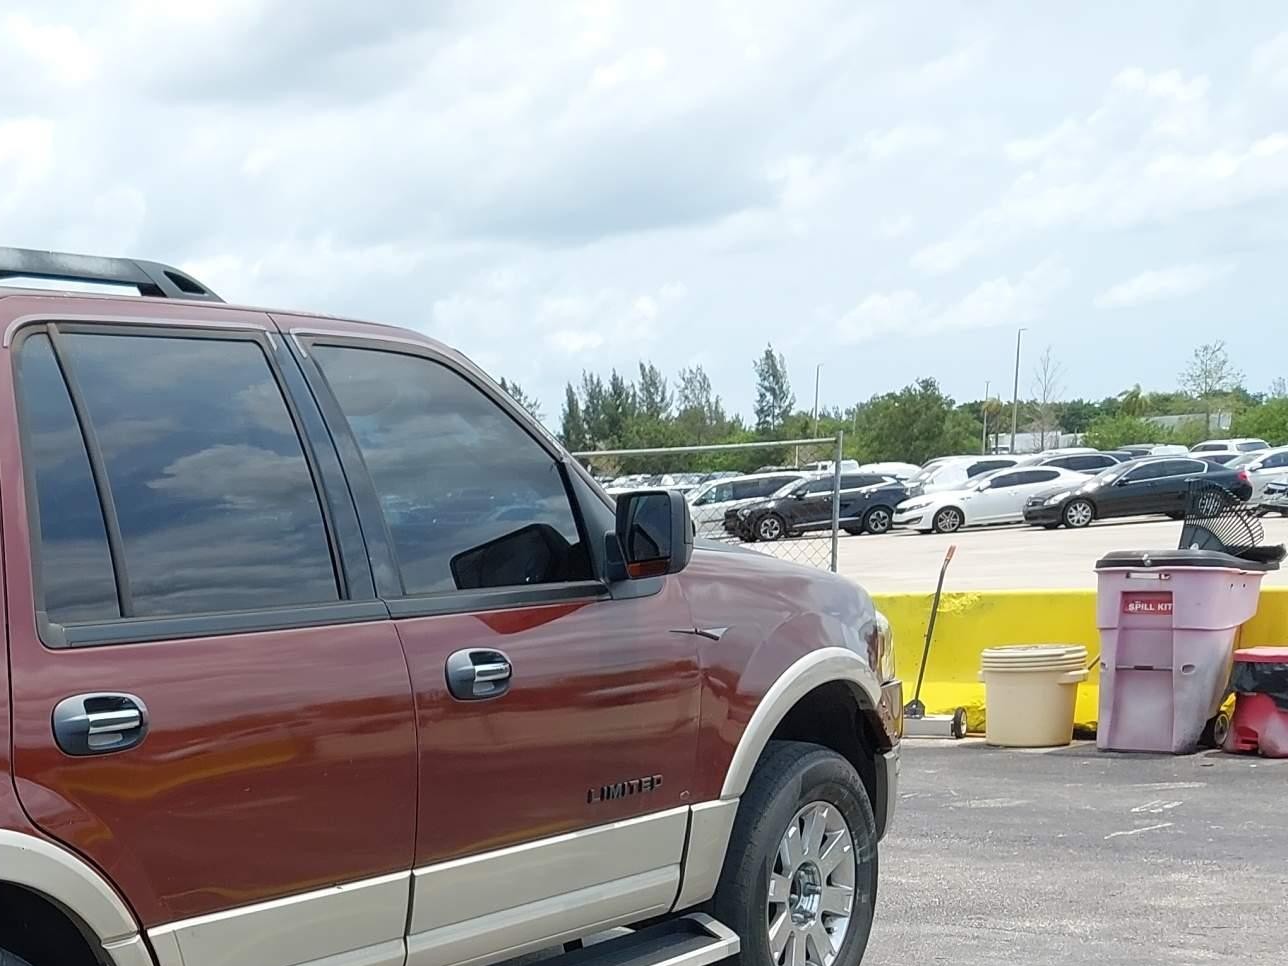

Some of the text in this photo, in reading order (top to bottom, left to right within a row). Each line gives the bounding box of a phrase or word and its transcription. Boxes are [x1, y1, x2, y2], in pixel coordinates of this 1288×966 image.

[1128, 602, 1173, 611] SPILL KIT
[587, 774, 663, 804] LIMITED
